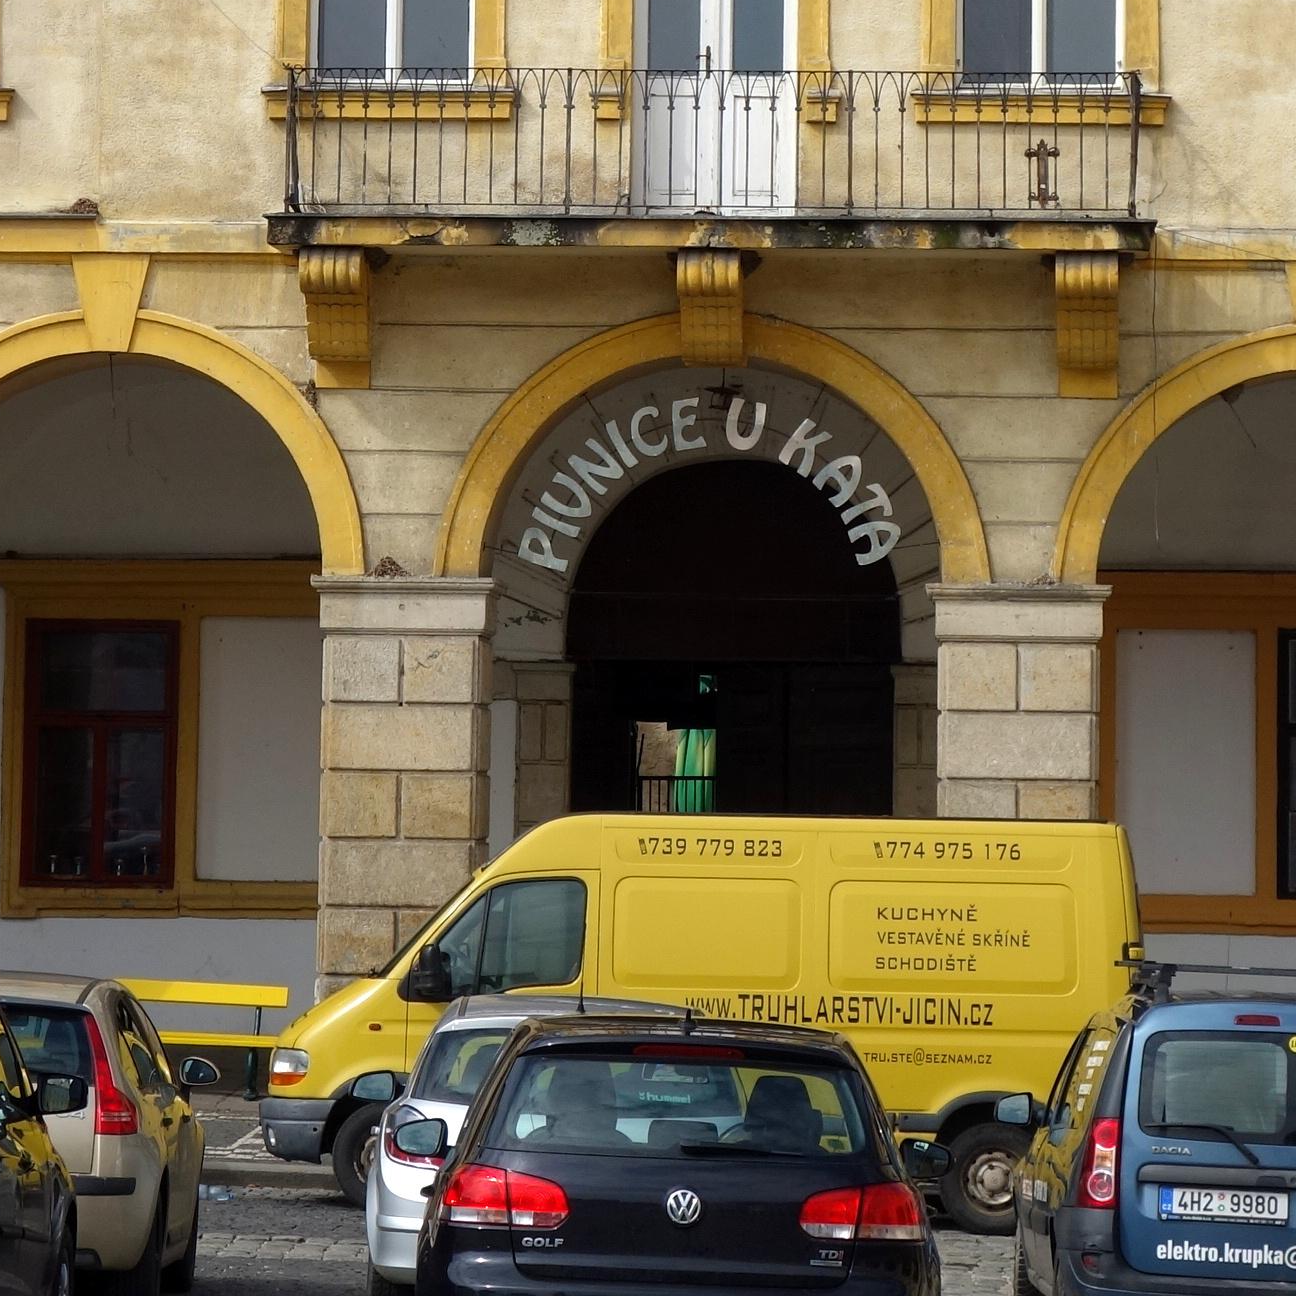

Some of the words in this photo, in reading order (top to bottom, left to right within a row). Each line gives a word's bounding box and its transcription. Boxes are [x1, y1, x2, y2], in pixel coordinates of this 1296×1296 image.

[725, 397, 767, 451] U
[778, 417, 902, 566] KATA
[648, 837, 687, 855] 739
[696, 839, 735, 856] 779
[743, 839, 783, 857] 823
[886, 841, 925, 859] 774
[934, 842, 974, 860] 975
[985, 843, 1022, 861] 176
[877, 904, 978, 923] KUCHYNĚ
[877, 927, 967, 946] VESTAVĚNÉ
[972, 929, 1032, 948] SKŘÍNĚ
[875, 954, 977, 972] SCHODIŠTĚ
[1151, 1146, 1192, 1156] DACIA
[1161, 1203, 1172, 1211] CZ
[1178, 1191, 1214, 1213] 4H2
[1230, 1193, 1279, 1215] 9980
[521, 1236, 564, 1248] GOLF
